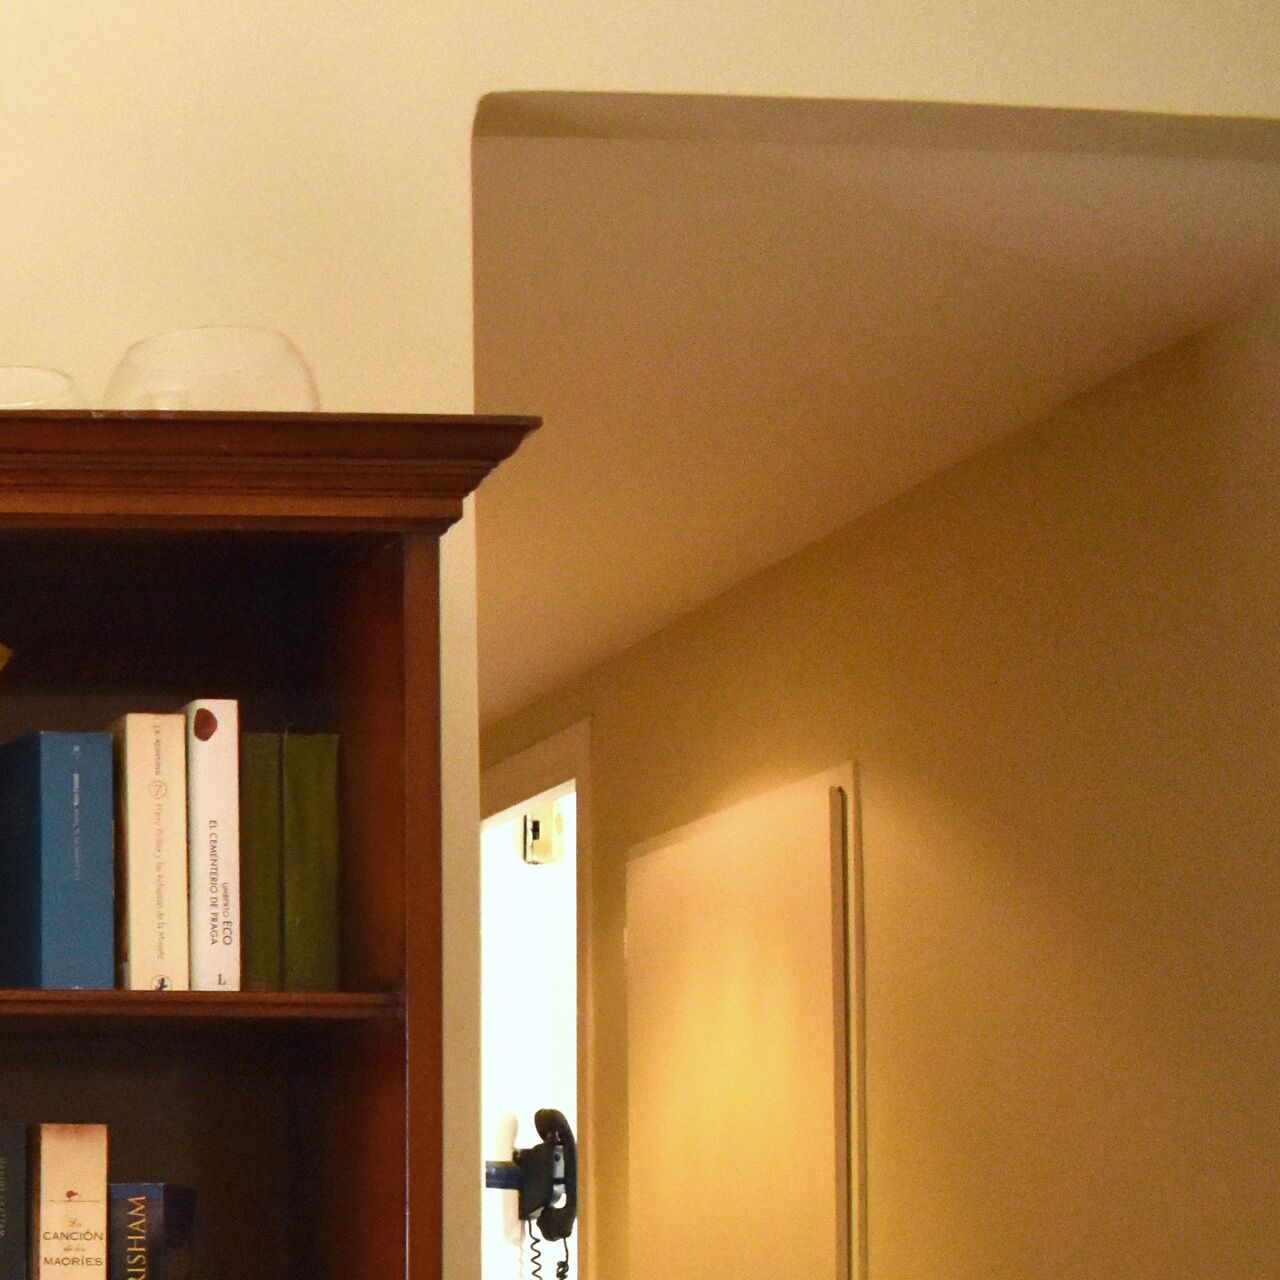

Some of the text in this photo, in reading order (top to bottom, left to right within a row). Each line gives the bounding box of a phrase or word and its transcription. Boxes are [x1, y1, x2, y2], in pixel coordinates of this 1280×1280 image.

[209, 820, 218, 830] EL
[209, 832, 219, 894] CEMENTERIO
[210, 897, 219, 909] DE
[222, 920, 233, 946] ECO
[42, 1230, 104, 1241] CANCIÓN
[44, 1256, 103, 1266] MAORÍES
